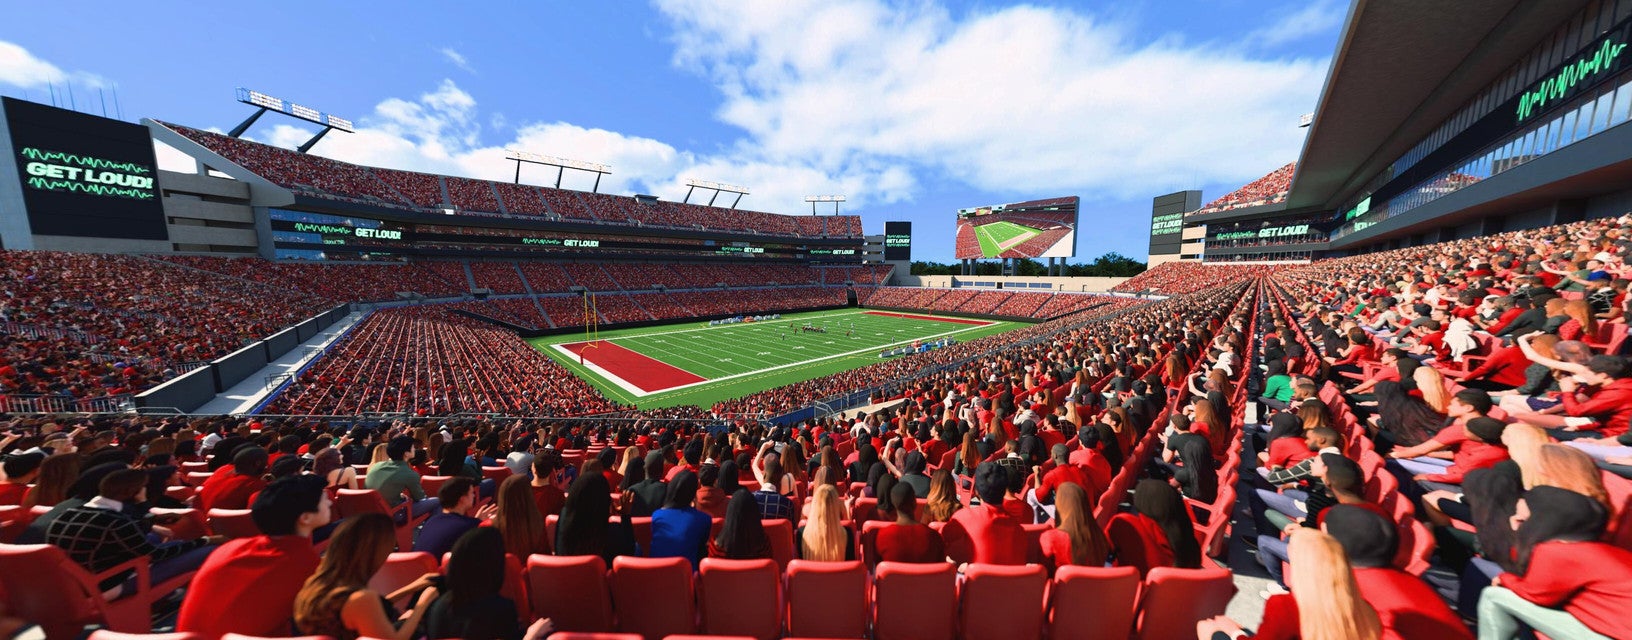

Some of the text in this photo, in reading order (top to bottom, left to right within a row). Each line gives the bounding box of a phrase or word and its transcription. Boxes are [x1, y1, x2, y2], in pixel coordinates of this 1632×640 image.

[26, 162, 154, 189] GET LOUD!
[355, 228, 402, 240] GET LOUD!
[1259, 225, 1309, 237] GET LOUD!
[564, 239, 578, 247] GET
